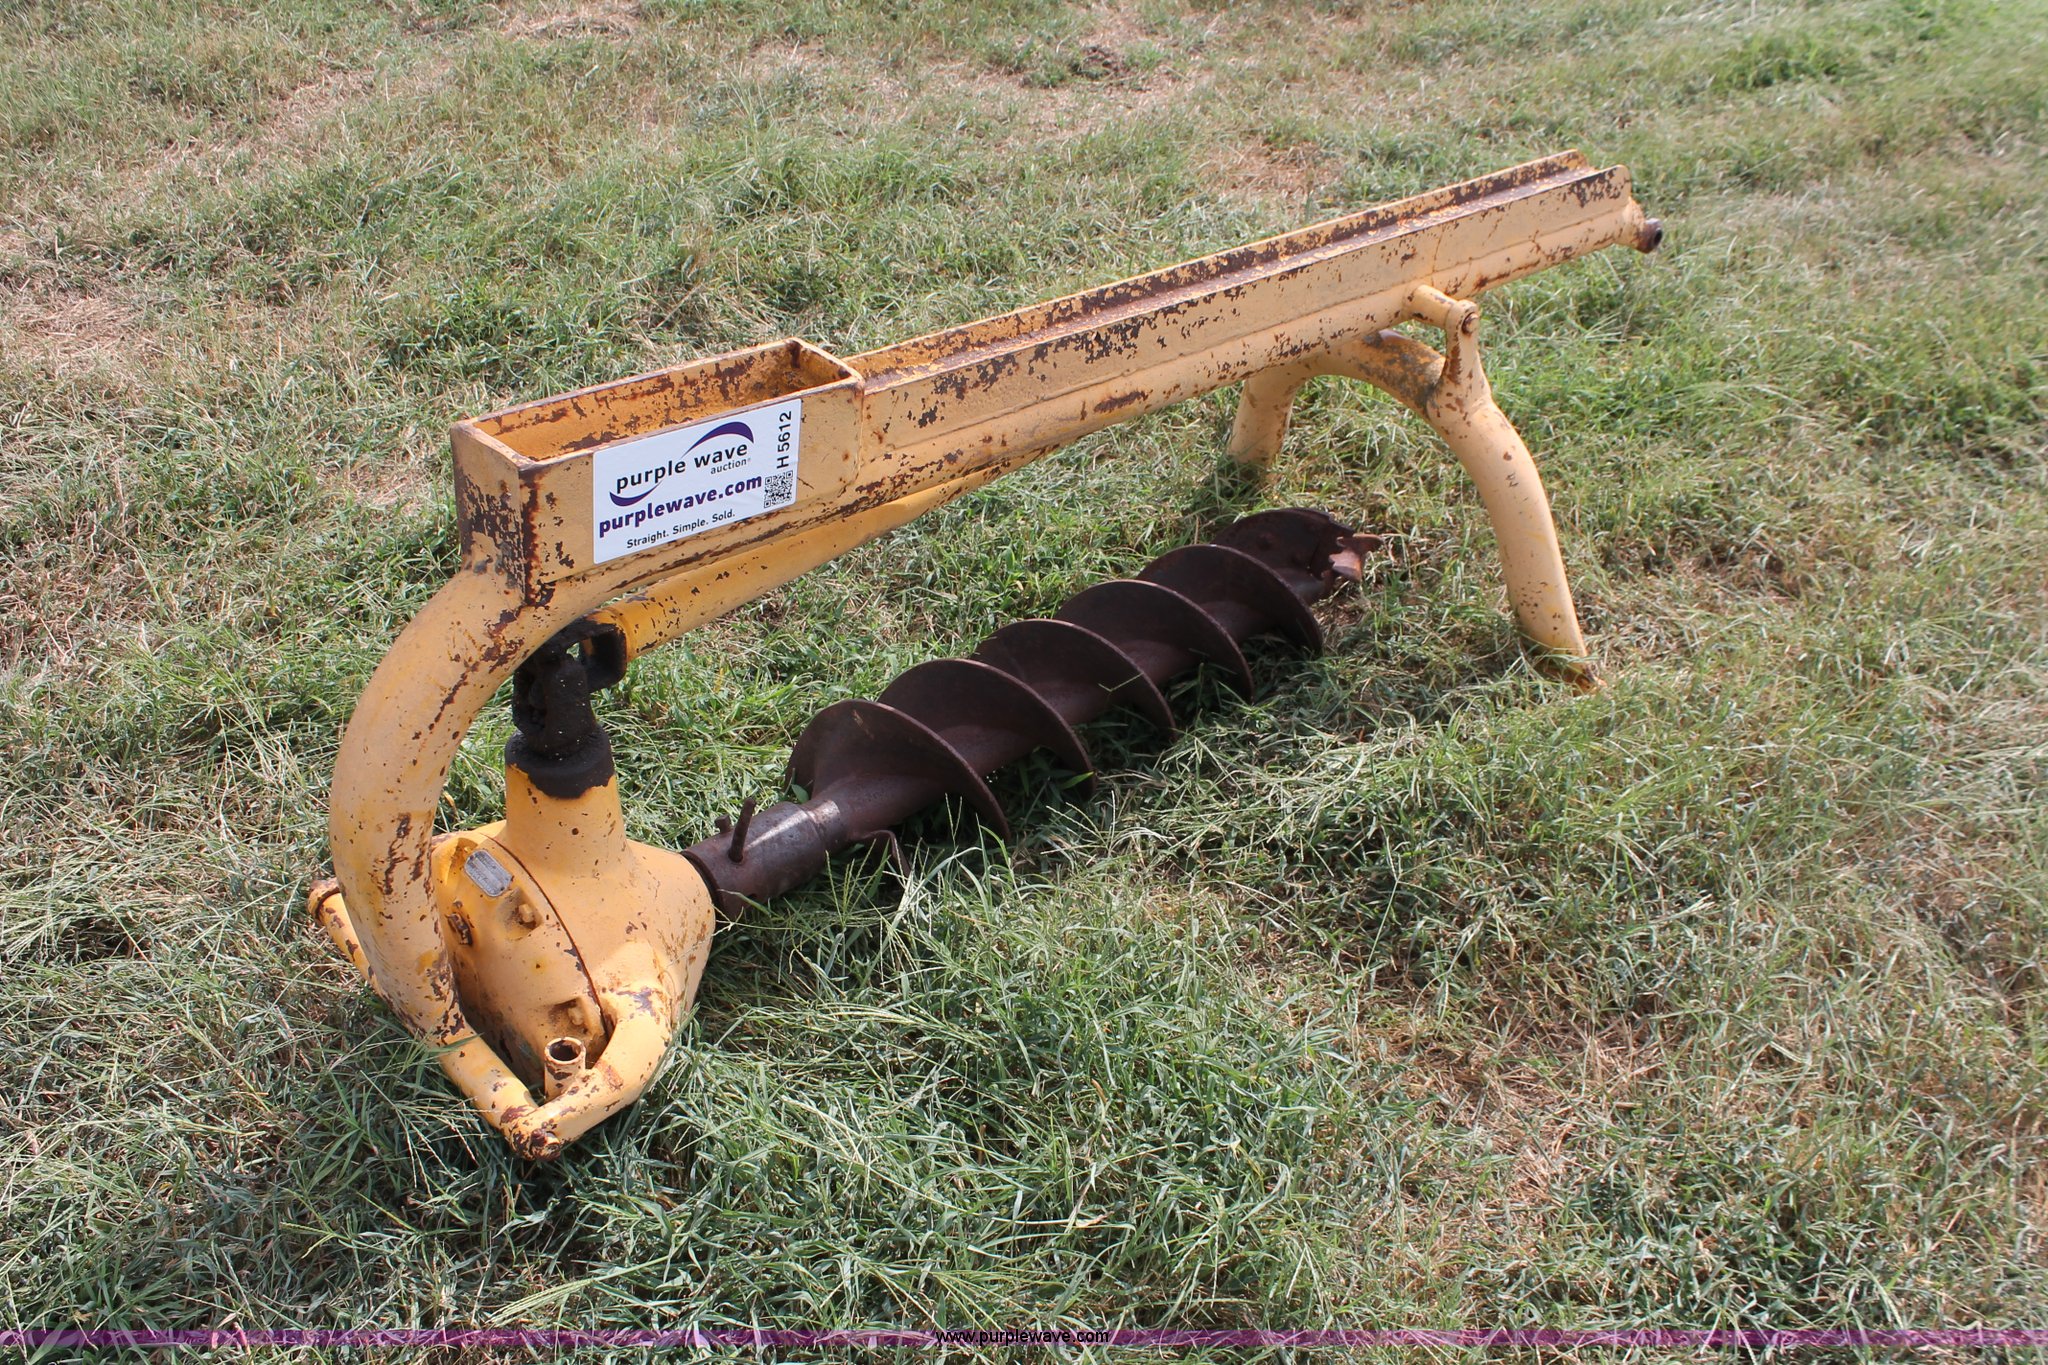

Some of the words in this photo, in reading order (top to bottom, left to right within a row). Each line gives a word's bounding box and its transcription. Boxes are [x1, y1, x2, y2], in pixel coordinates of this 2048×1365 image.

[616, 459, 687, 495] purple
[693, 443, 748, 469] wave
[710, 458, 748, 475] auction
[599, 475, 763, 539] purplewave.com
[626, 530, 670, 549] Straight.
[672, 516, 709, 535] Simple.
[712, 508, 736, 523] Sold.
